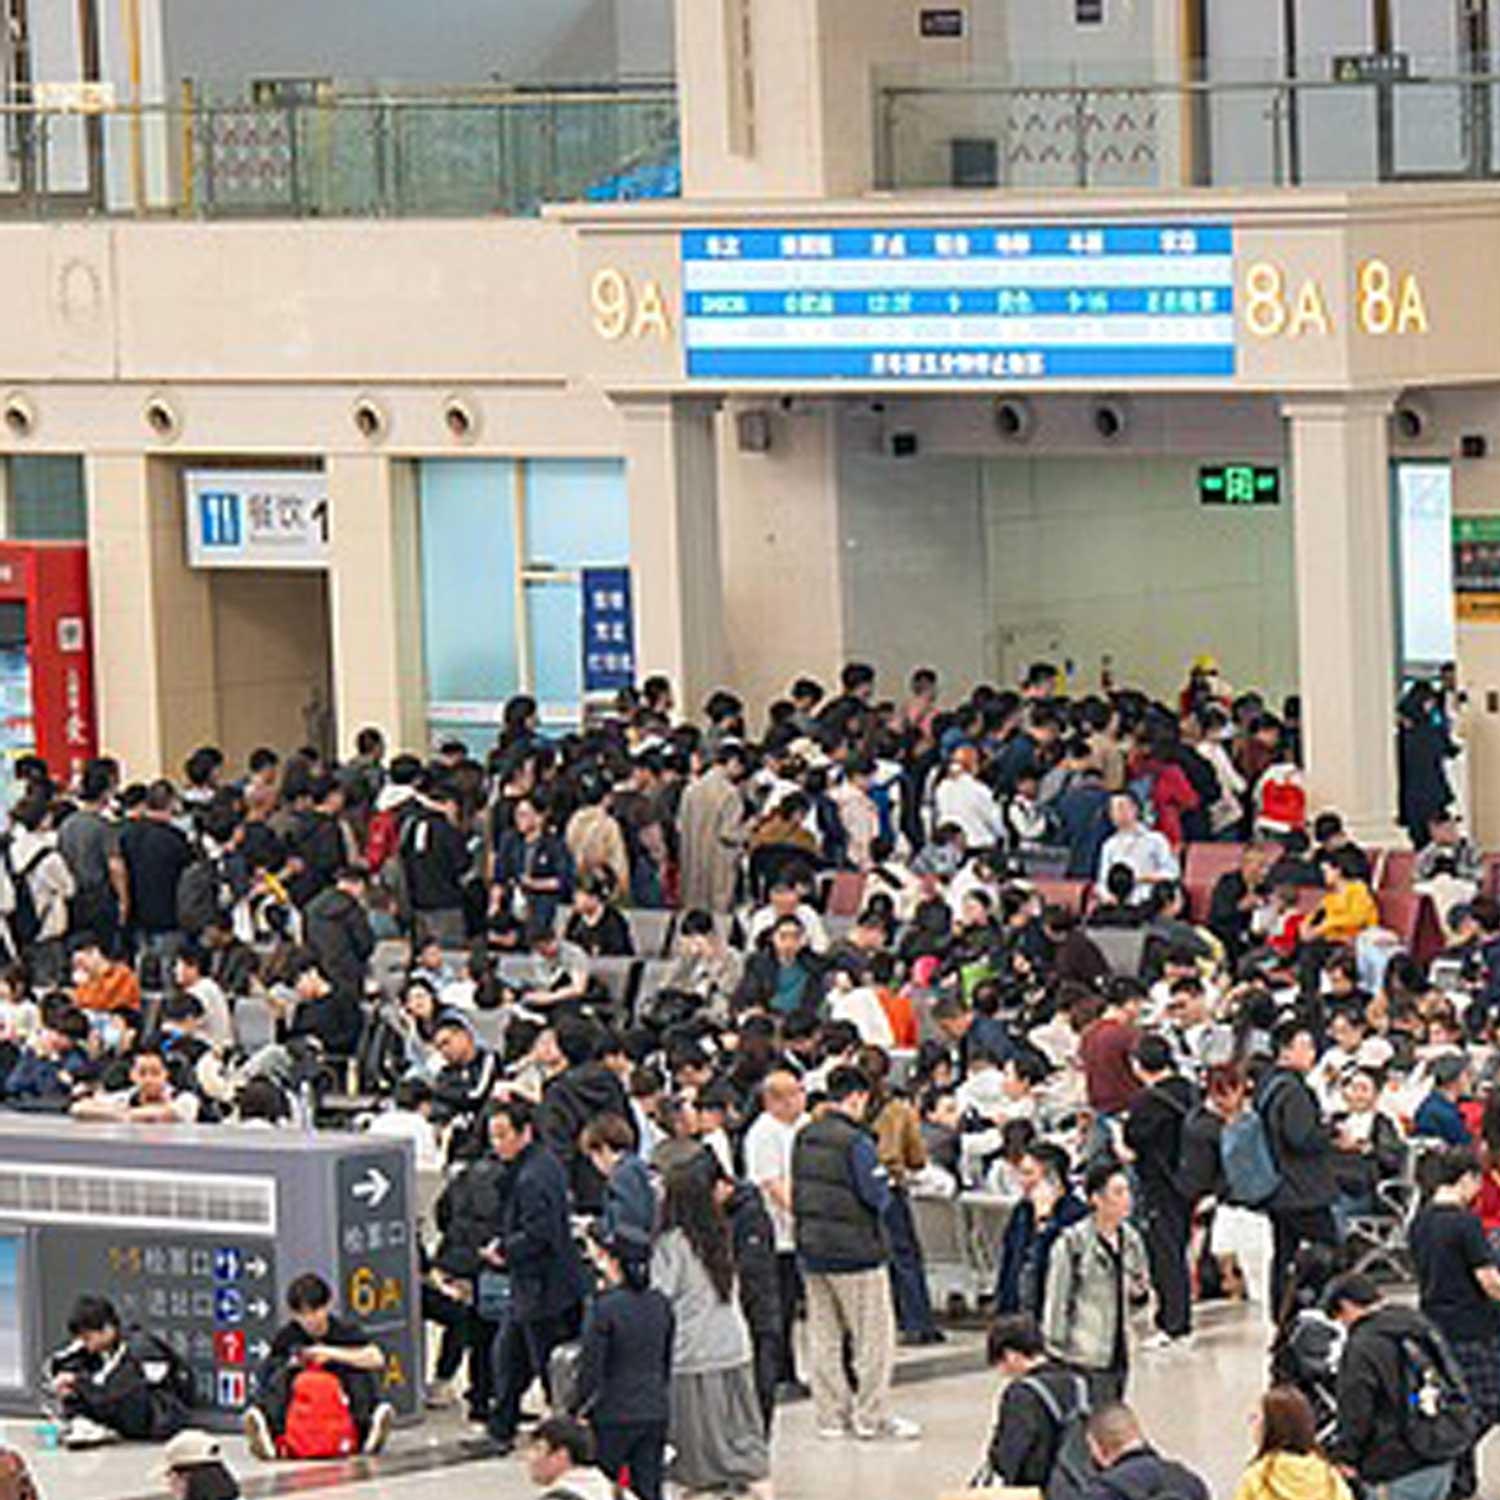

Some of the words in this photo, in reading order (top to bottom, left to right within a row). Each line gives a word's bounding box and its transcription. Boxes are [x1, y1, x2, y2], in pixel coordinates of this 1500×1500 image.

[592, 267, 672, 342] 9A
[1246, 262, 1336, 338] 8A
[1358, 260, 1428, 335] 8A
[347, 1264, 403, 1318] 6A
